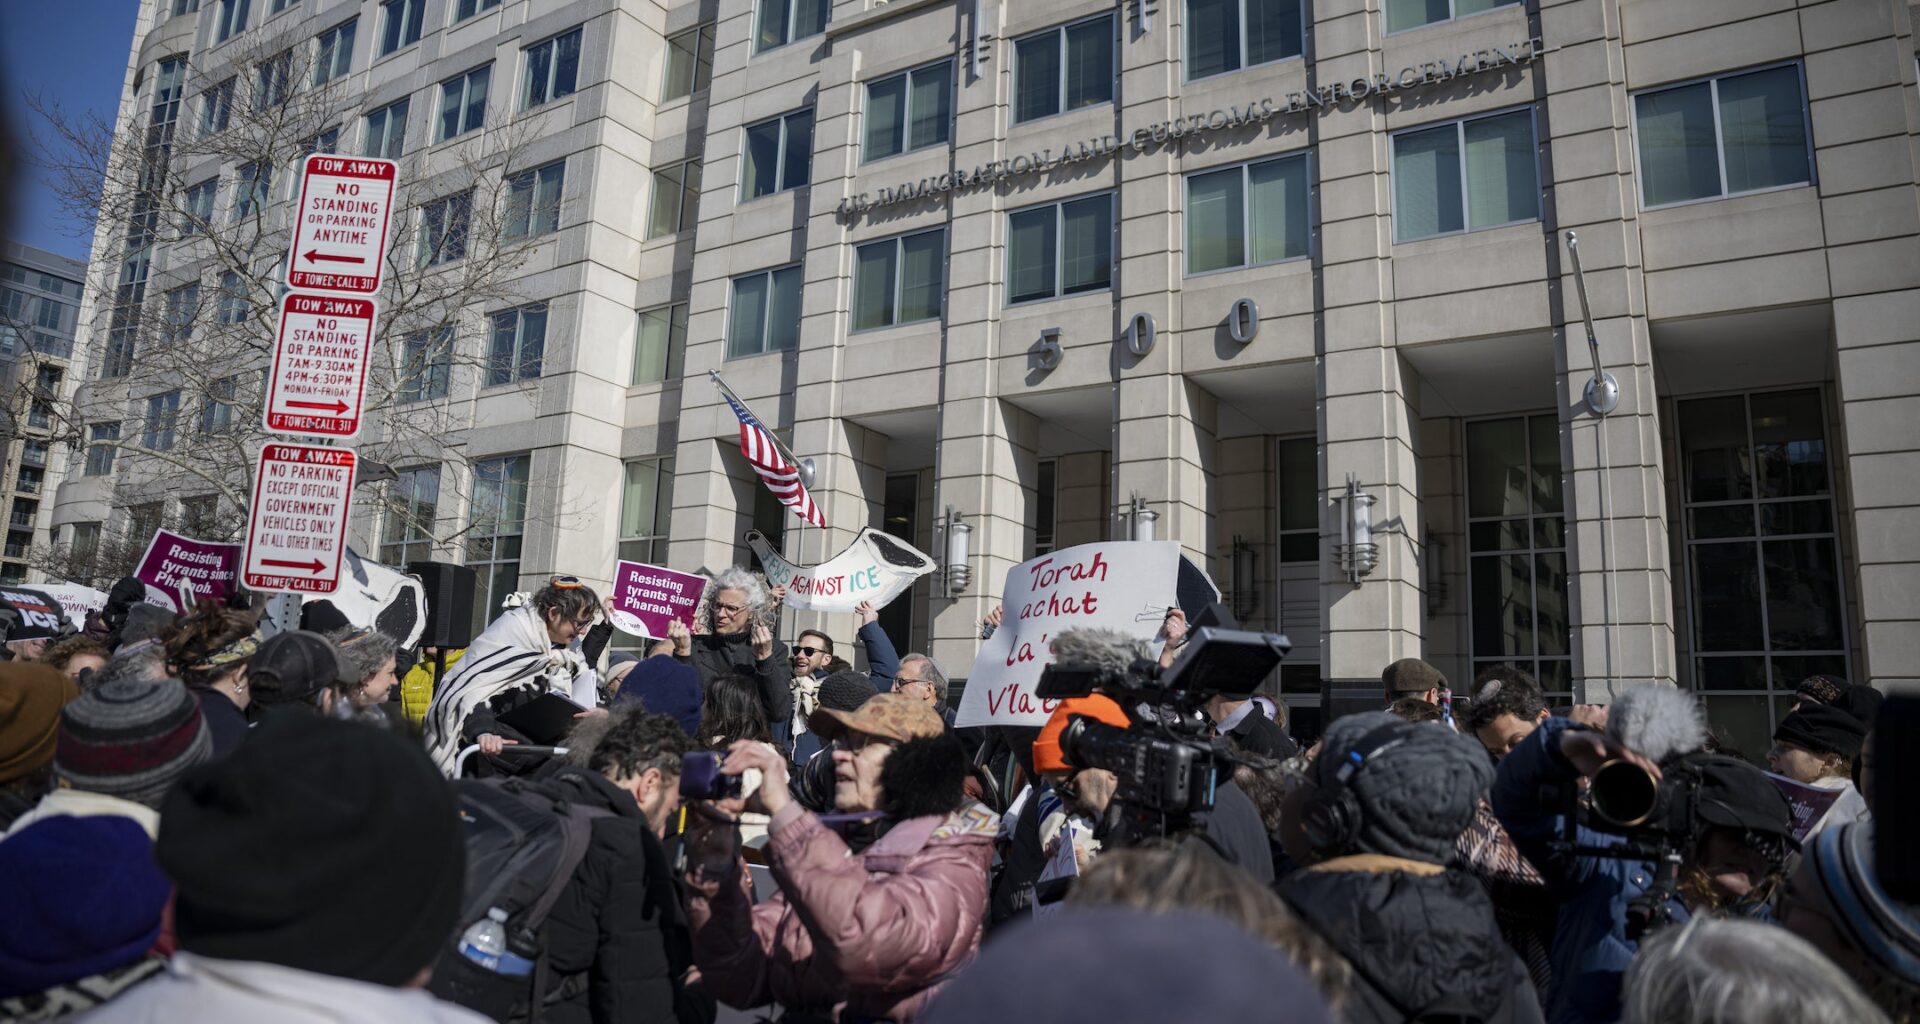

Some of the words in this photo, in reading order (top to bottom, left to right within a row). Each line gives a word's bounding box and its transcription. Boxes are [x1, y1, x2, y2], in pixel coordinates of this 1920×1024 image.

[877, 148, 1052, 208] IMMIGRATION
[1058, 134, 1119, 165] AND
[1130, 97, 1274, 151] CUSTOMS
[1285, 37, 1542, 114] ENFORCEMENT
[317, 160, 344, 172] TOW
[348, 162, 386, 175] AWAY
[336, 183, 359, 196] NO
[313, 198, 378, 214] STANDING
[308, 214, 323, 224] OR
[326, 215, 376, 228] PARKING
[314, 229, 368, 244] ANYTIME
[293, 273, 302, 284] IF
[361, 279, 373, 289] 311
[295, 299, 321, 311] TOW
[325, 302, 363, 315] AWAY
[317, 318, 337, 330] NO
[293, 330, 357, 345] STANDING
[288, 344, 303, 355] OR
[308, 345, 358, 359] PARKING
[284, 384, 350, 397] MONDAY-FRIDAY
[273, 414, 282, 425] IF
[340, 420, 352, 431] 311
[274, 447, 301, 461] TOW
[305, 450, 344, 464] AWAY
[270, 464, 286, 477] NO
[291, 466, 342, 481] PARKING
[267, 481, 299, 496] EXCEPT
[301, 484, 340, 499] OFFICIAL
[266, 499, 336, 516] GOVERNMENT
[263, 516, 307, 532] VEHICLES
[310, 520, 336, 533] ONLY
[259, 535, 270, 545] AT
[271, 535, 284, 547] ALL
[287, 536, 309, 549] OTHER
[312, 538, 333, 551] TIMES
[168, 544, 223, 568] Resisting
[162, 559, 209, 579] tyrants
[210, 568, 234, 580] since
[762, 549, 791, 584] JEWS
[789, 574, 845, 596] AGAINST
[849, 565, 881, 592] ICE
[1031, 552, 1108, 591] Torah
[250, 575, 261, 585] IF
[319, 581, 331, 591] 311
[630, 571, 683, 593] Resisting
[627, 585, 667, 601] tyrants
[670, 593, 694, 606] since
[625, 597, 674, 616] Pharaoh.
[1020, 591, 1097, 620] achat
[18, 608, 60, 632] ICE
